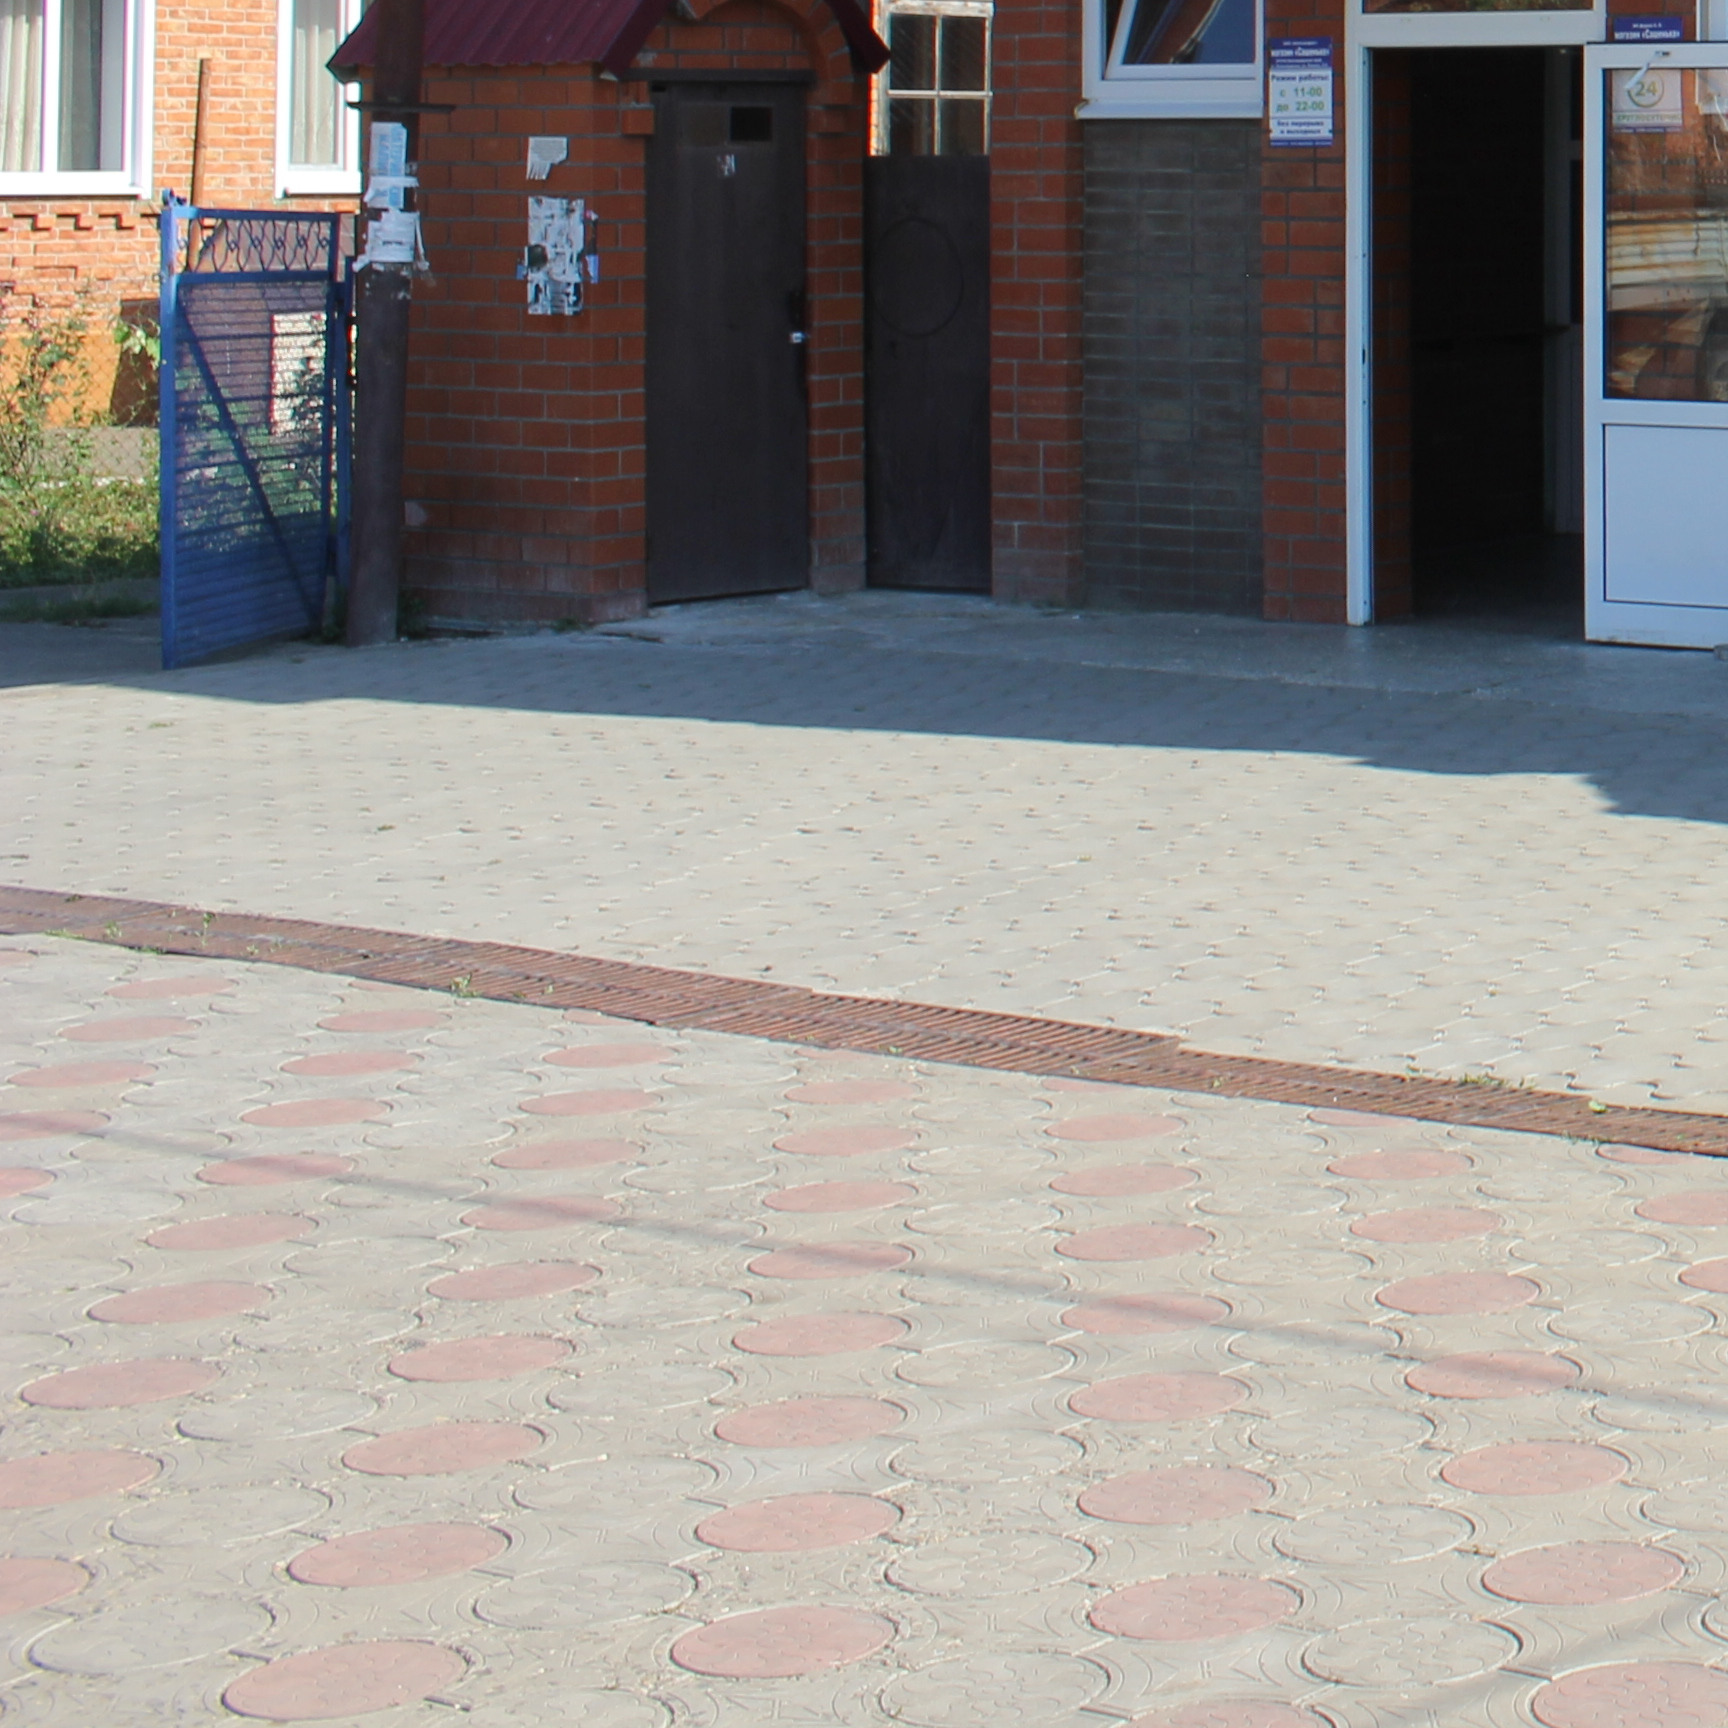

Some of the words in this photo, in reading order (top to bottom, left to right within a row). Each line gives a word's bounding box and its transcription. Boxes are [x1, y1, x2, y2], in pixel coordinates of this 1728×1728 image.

[1294, 86, 1323, 98] 11-00
[1634, 81, 1659, 97] 24
[1296, 101, 1326, 112] 22-00
